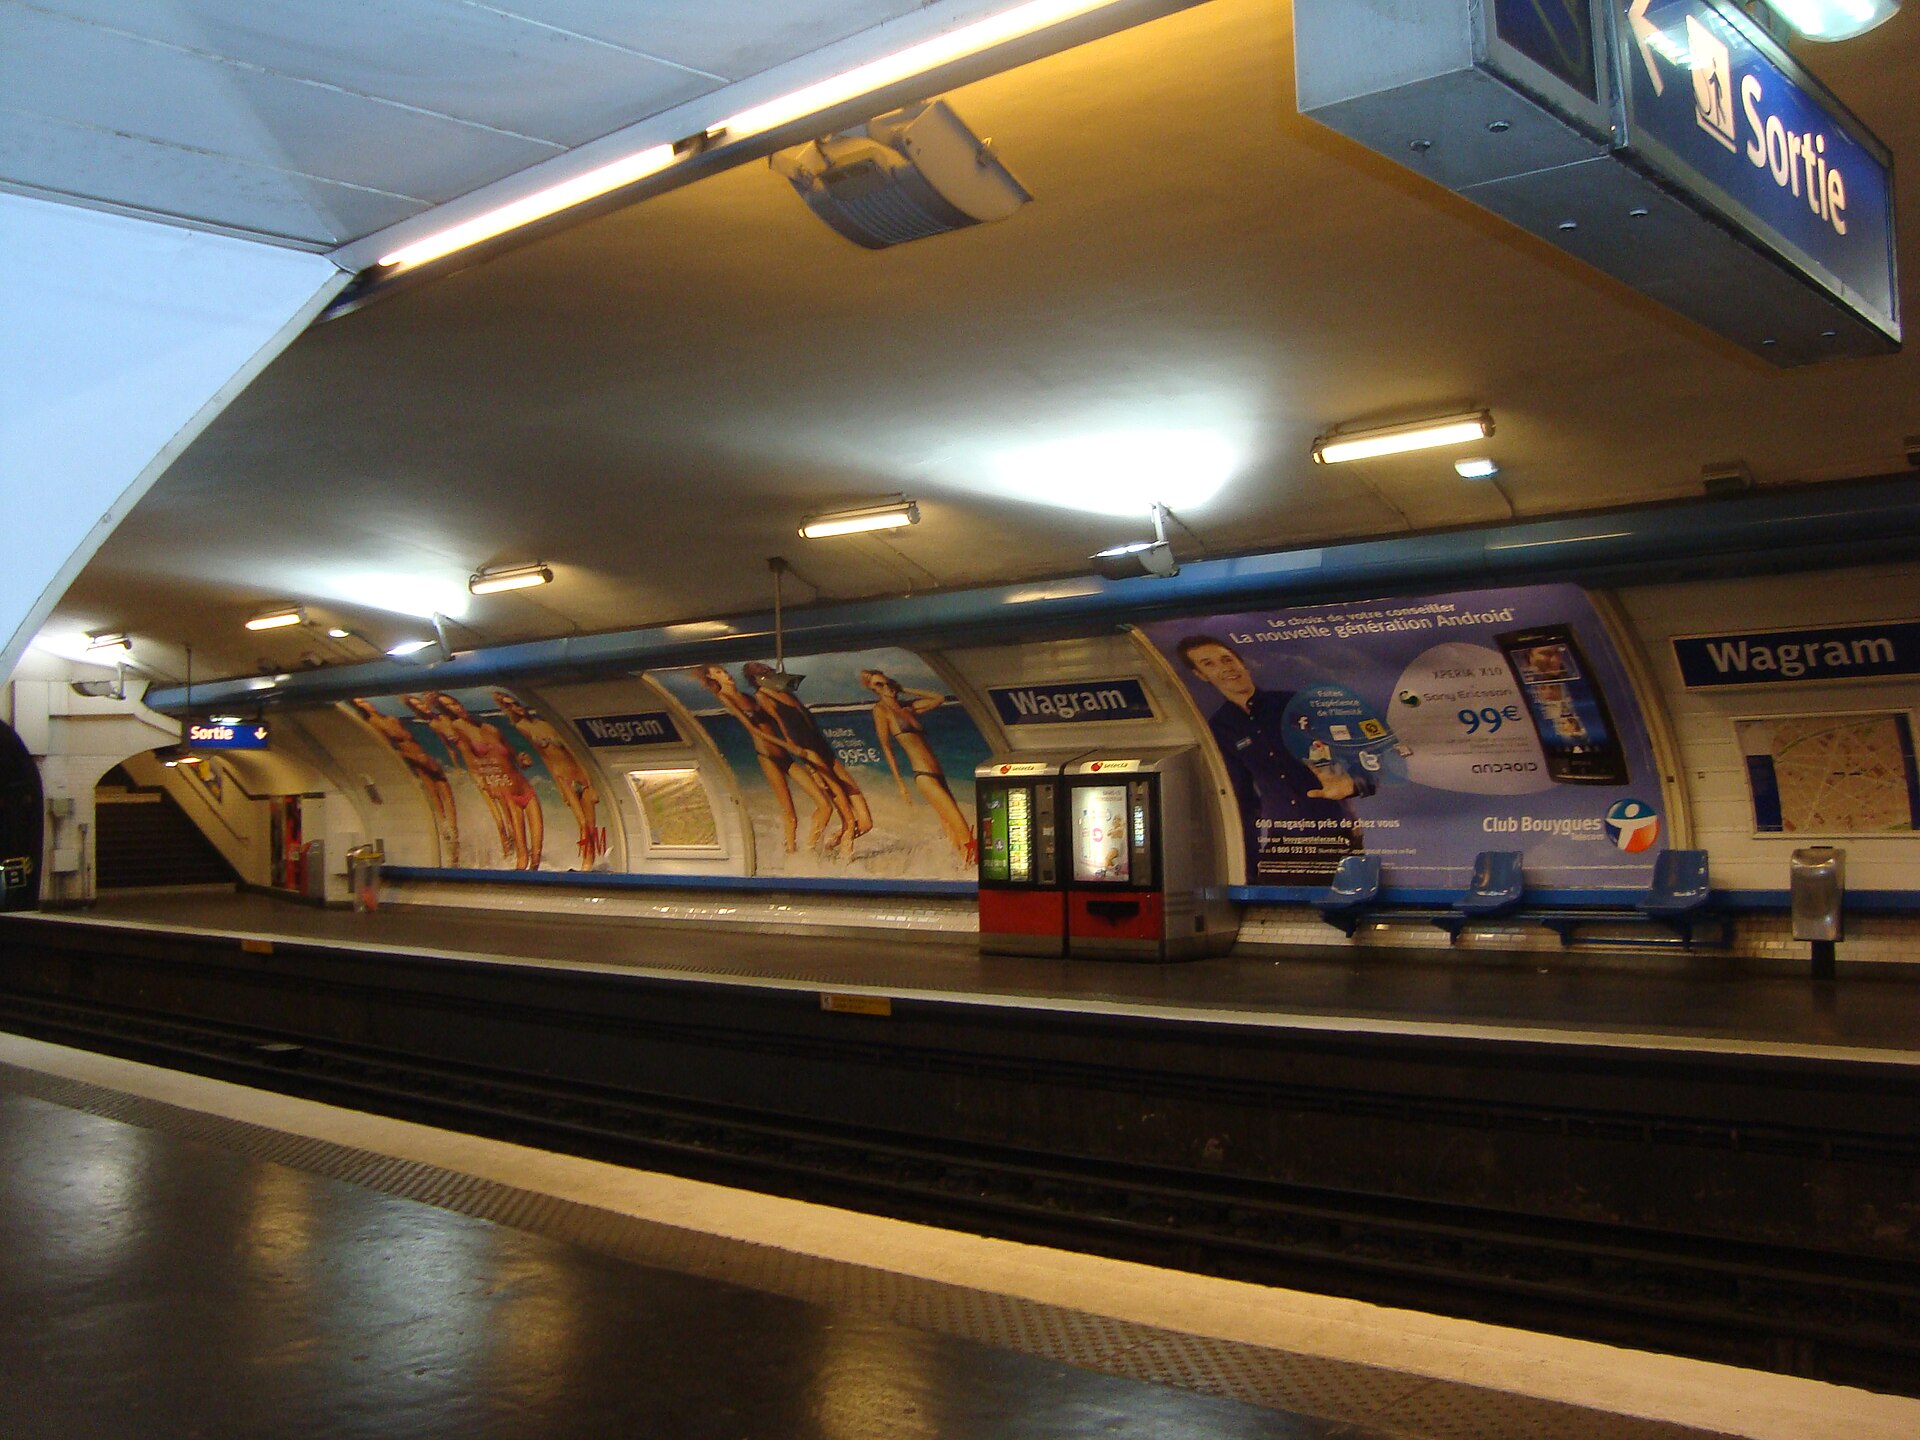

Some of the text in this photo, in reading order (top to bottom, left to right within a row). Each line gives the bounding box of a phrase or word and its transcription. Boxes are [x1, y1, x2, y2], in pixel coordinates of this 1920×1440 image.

[1741, 74, 1847, 235] Sortie
[1267, 619, 1286, 628] Le
[1327, 613, 1345, 623] de
[1346, 610, 1384, 621] votre
[1385, 603, 1456, 617] conseiller
[1229, 632, 1254, 644] La
[1255, 624, 1332, 642] nouvelle
[1334, 616, 1433, 639] génération
[1706, 637, 1896, 677] Wagram
[1008, 689, 1128, 719] Wagram
[1424, 687, 1513, 702] Sony Ericsson
[190, 725, 235, 740] Sortie
[586, 719, 665, 742] Wagram
[1457, 705, 1522, 735] 99€
[1274, 818, 1316, 831] magasins
[1318, 818, 1338, 831] près
[1340, 818, 1351, 828] de
[1353, 818, 1375, 830] chez
[1377, 819, 1400, 828] vous
[1482, 816, 1601, 836] Club Bouygues
